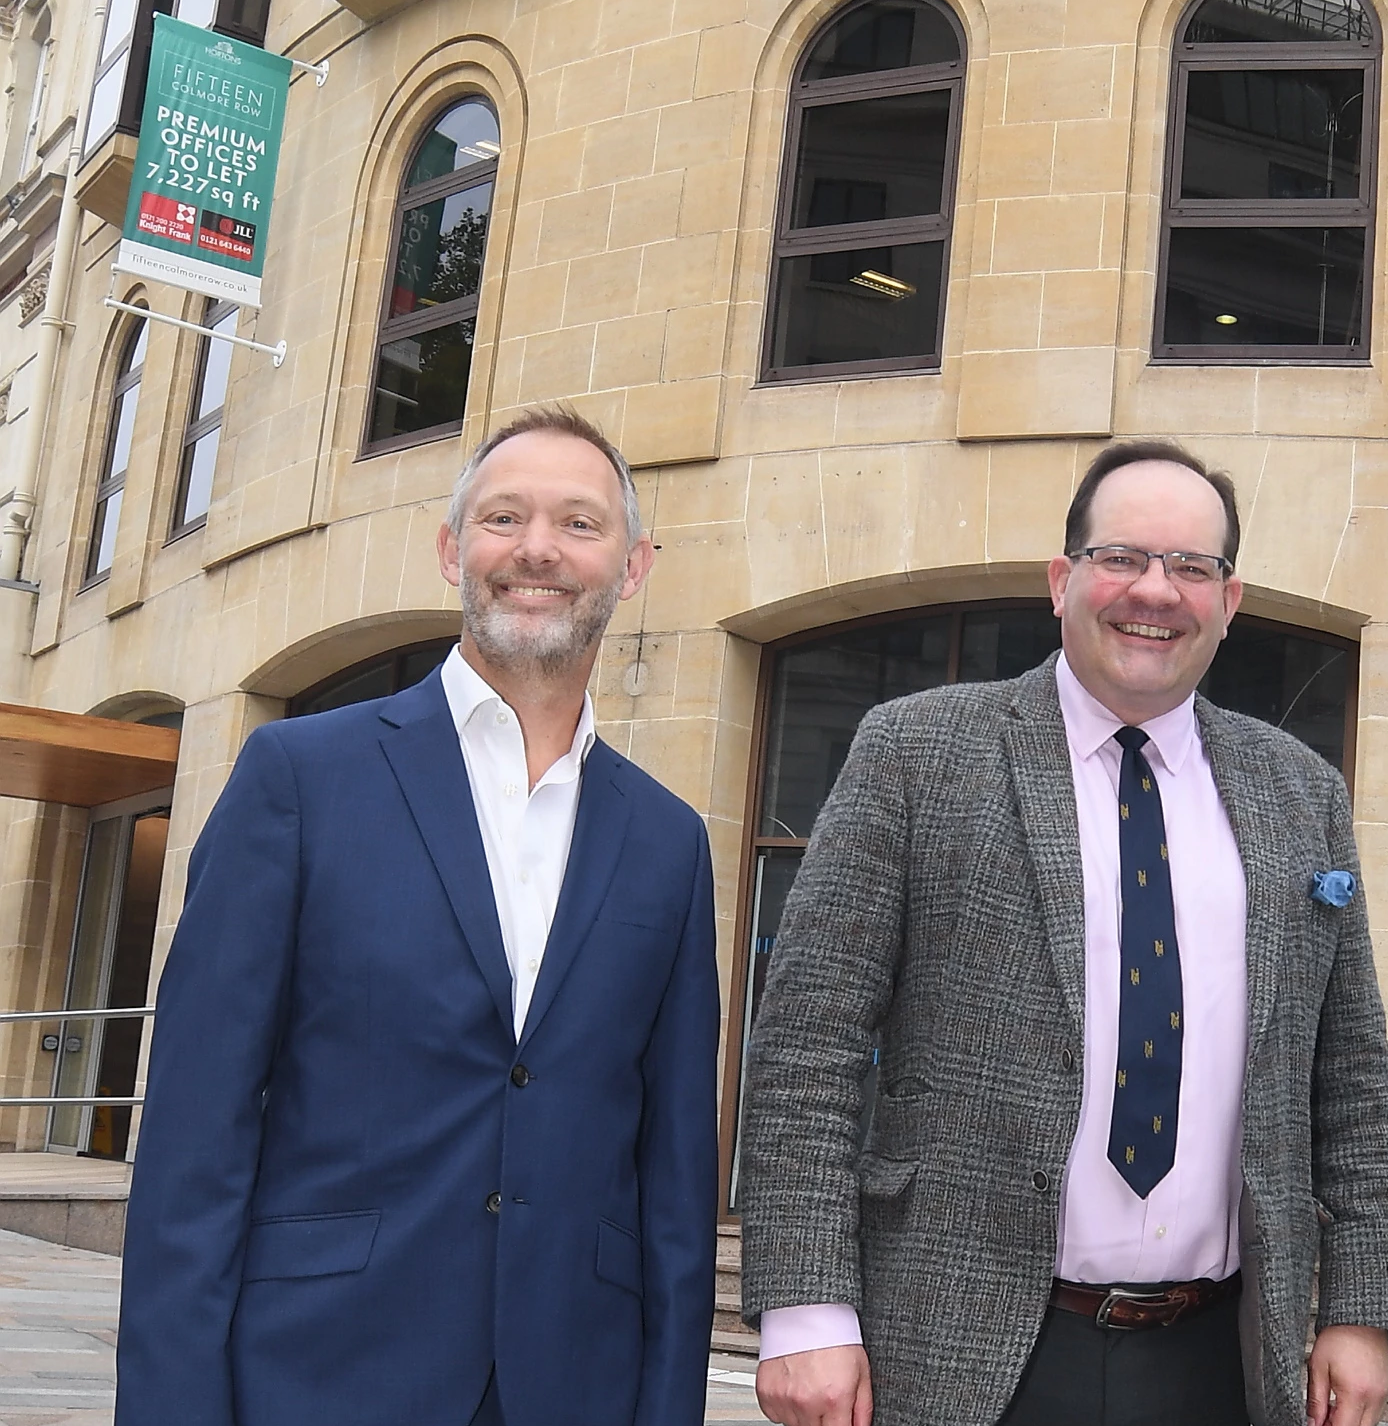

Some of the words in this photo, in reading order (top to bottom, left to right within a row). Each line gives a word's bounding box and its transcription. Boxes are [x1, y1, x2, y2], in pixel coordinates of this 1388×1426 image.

[205, 47, 242, 65] HORTONS
[171, 81, 230, 108] COLMORE
[234, 101, 262, 118] ROW
[173, 63, 263, 107] FIFTEEN
[157, 105, 265, 156] PREMIUM
[161, 128, 257, 171] OFFICES
[146, 162, 210, 194] 7,227
[210, 186, 234, 209] sq
[242, 191, 261, 211] ft
[166, 147, 199, 172] TO
[207, 161, 248, 187] LET
[139, 219, 167, 234] Knight
[168, 227, 191, 242] Frank
[200, 234, 218, 246] 0121
[218, 239, 233, 250] 643
[233, 224, 253, 239] JLL
[132, 254, 248, 293] fifteencolmorerow.co.uk
